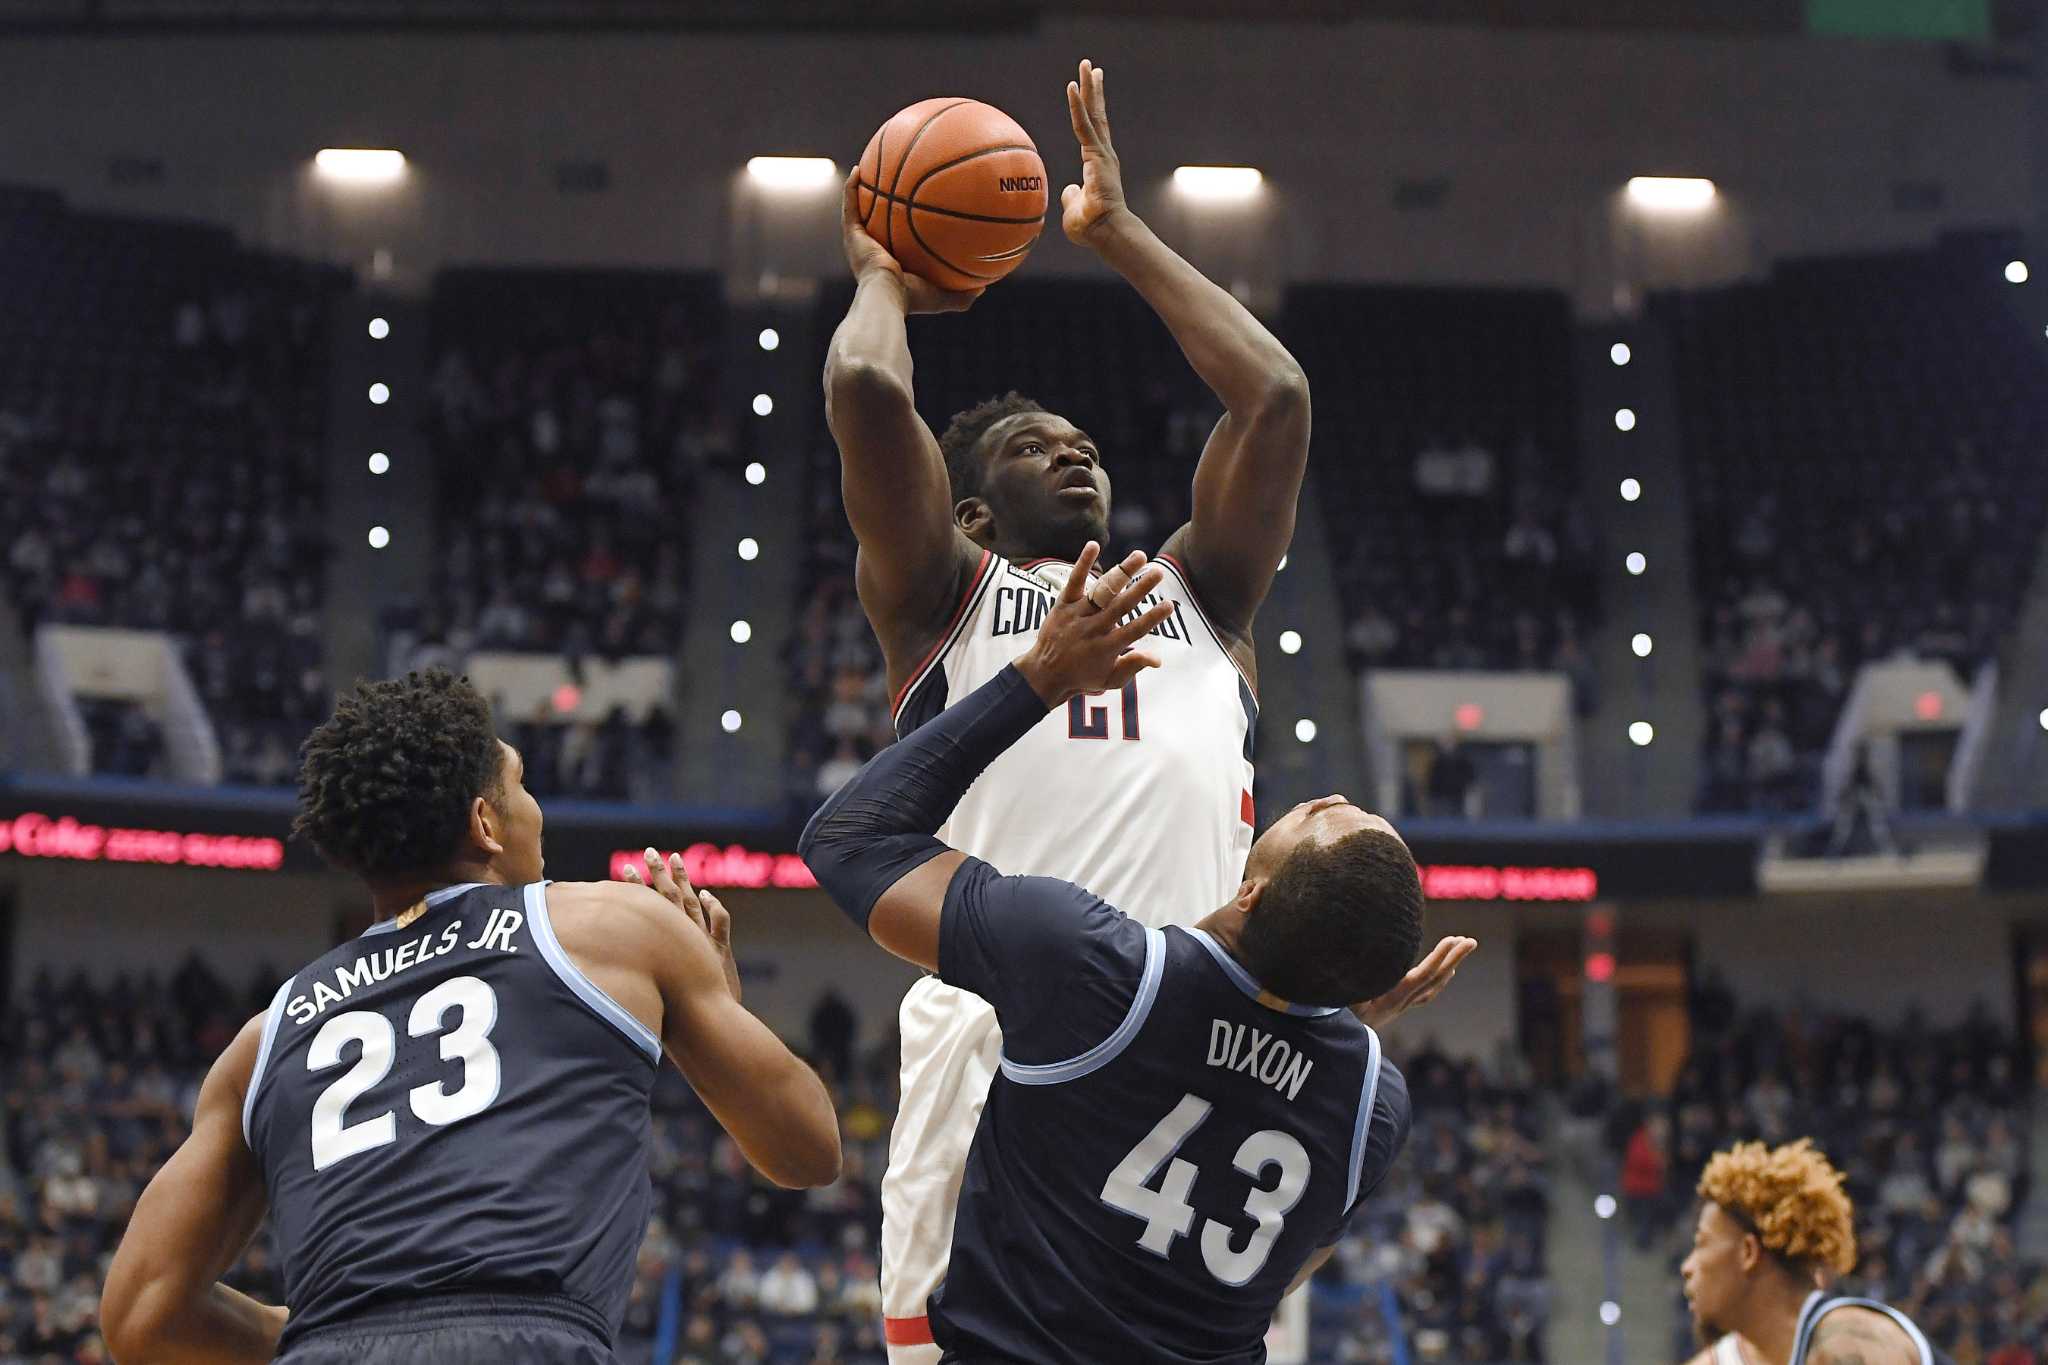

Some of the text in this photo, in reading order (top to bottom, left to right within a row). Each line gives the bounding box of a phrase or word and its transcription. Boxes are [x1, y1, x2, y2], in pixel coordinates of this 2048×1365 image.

[999, 177, 1042, 192] UCONN
[286, 908, 524, 1025] SAMUELS JR.
[306, 975, 501, 1173] 23
[1206, 1018, 1314, 1101] DIXON
[1100, 1092, 1312, 1288] 43
